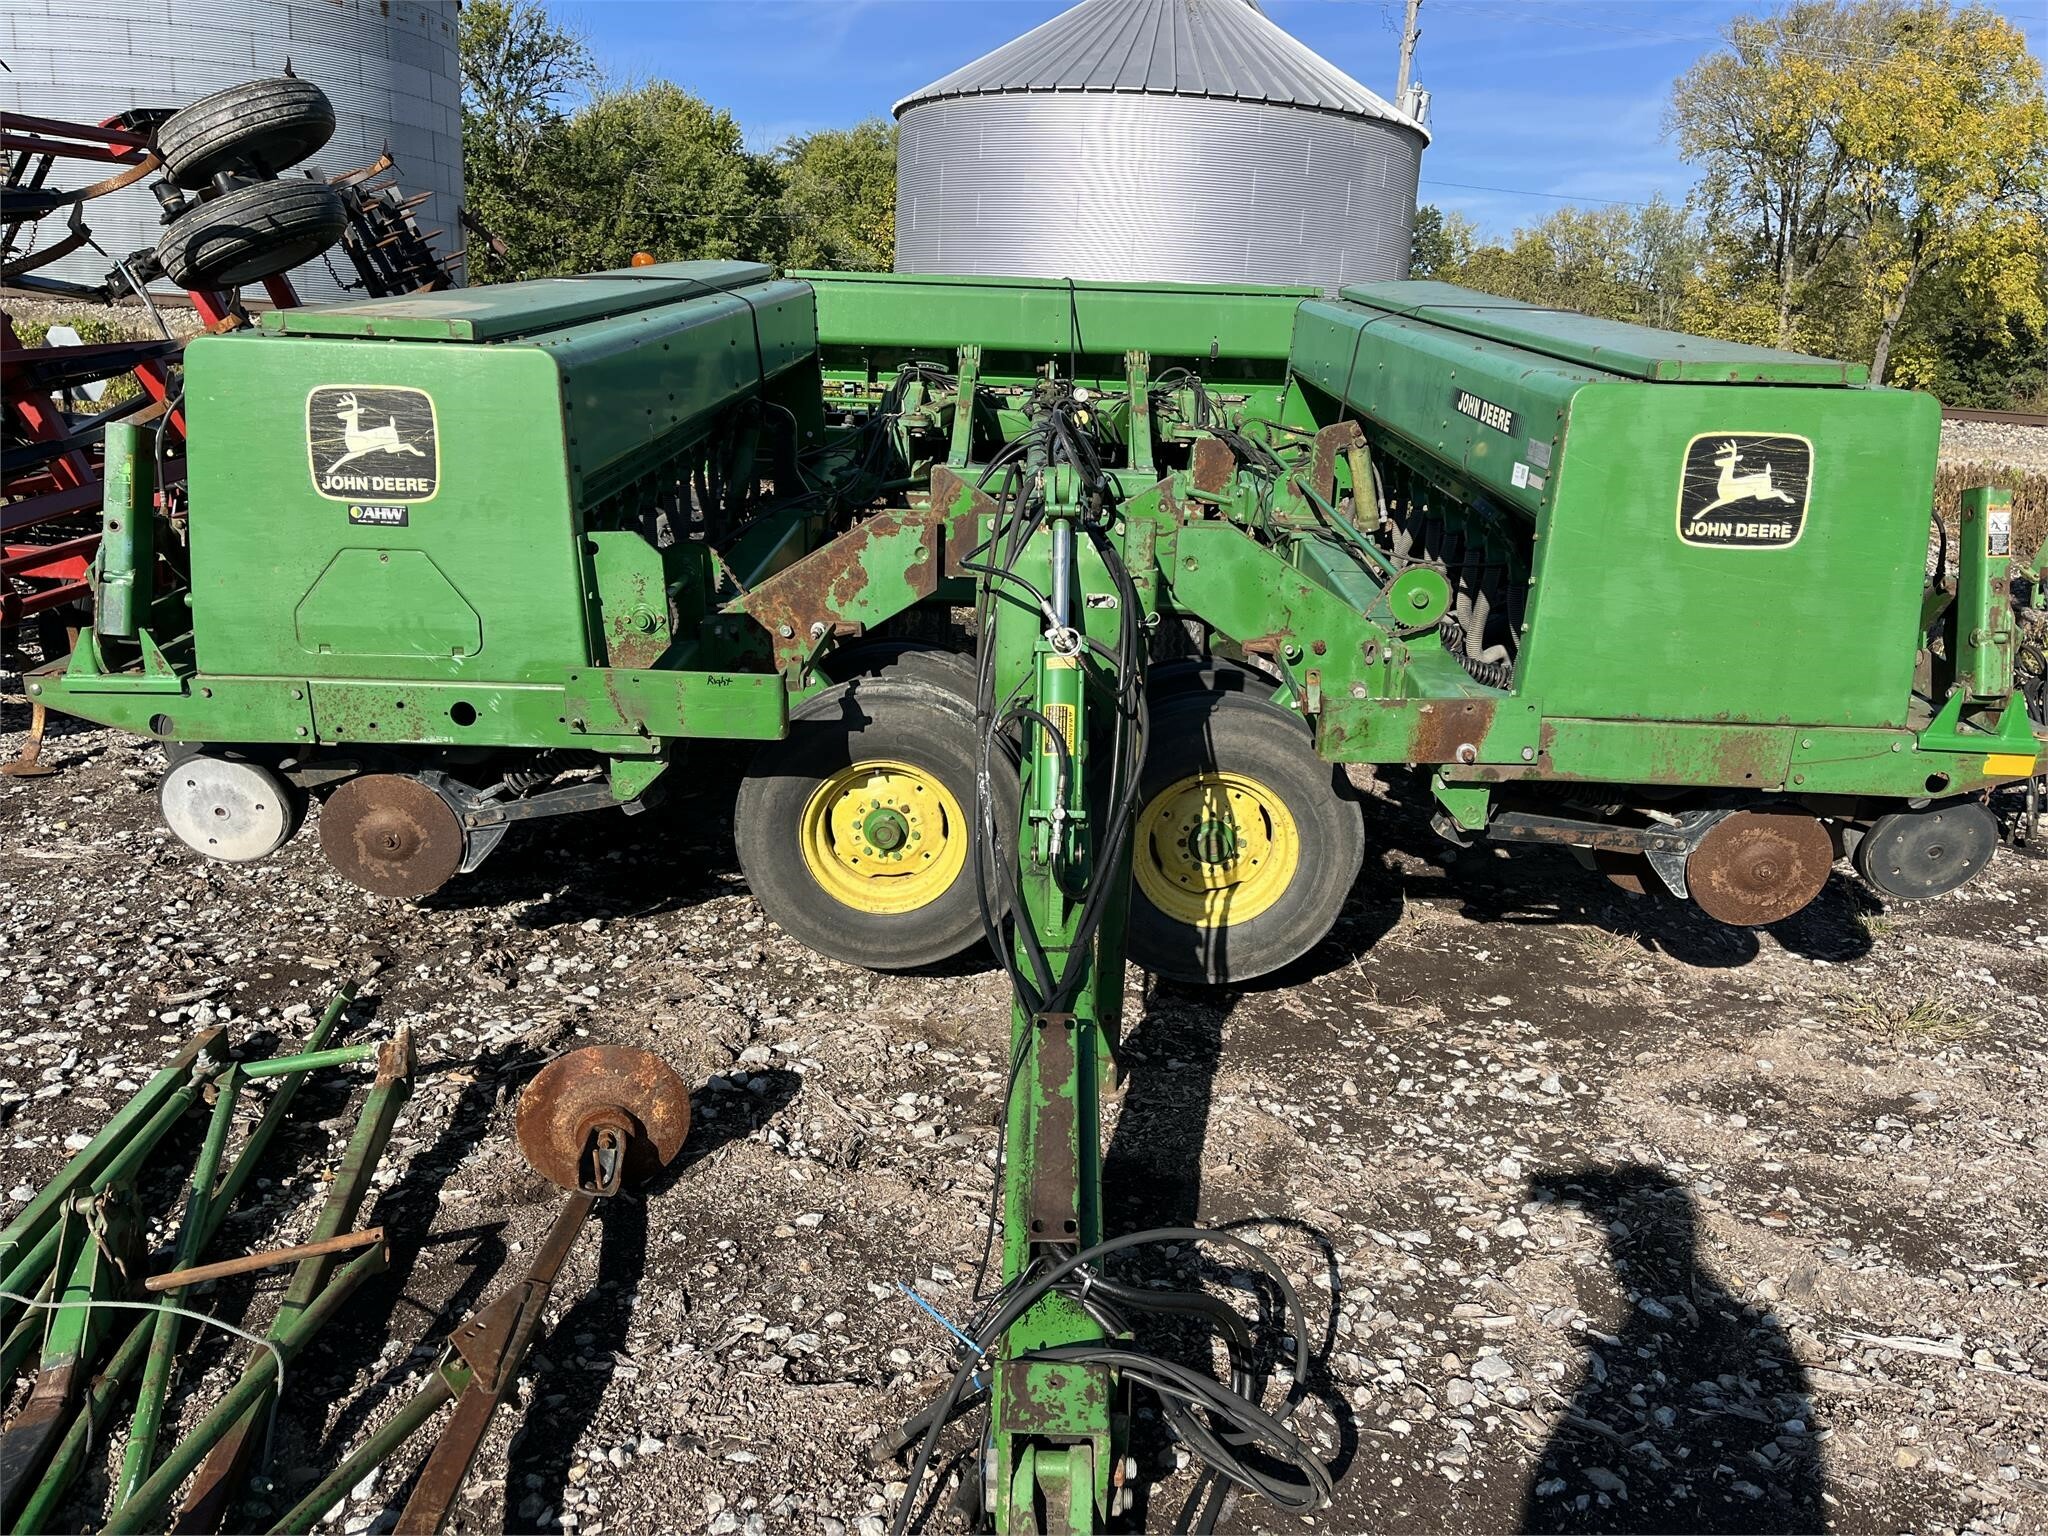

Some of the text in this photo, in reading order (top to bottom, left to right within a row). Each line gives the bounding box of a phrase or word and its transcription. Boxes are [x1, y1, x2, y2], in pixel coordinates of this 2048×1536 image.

[1457, 391, 1512, 433] JOHN DEERE
[321, 476, 429, 492] JOHN DEERE
[363, 507, 403, 520] AHW
[1685, 522, 1793, 539] JOHN DEERE
